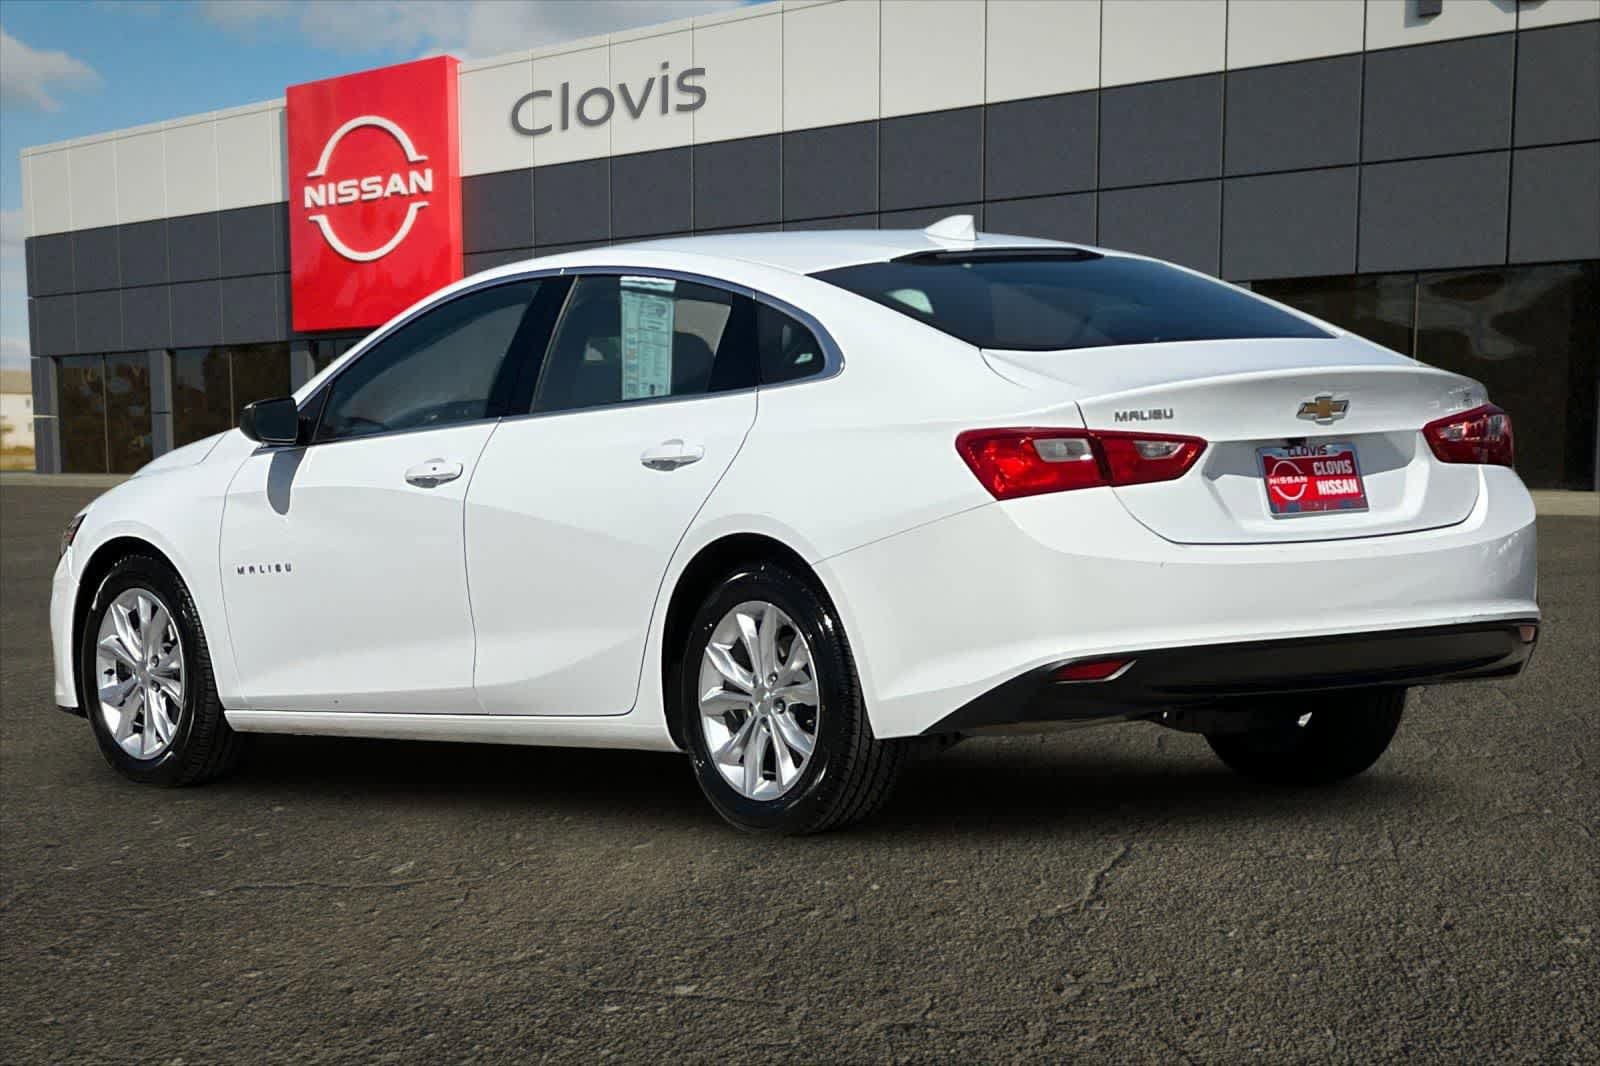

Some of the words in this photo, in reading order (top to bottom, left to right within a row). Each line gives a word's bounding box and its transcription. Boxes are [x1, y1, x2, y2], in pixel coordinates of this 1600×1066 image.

[511, 61, 707, 136] Clovis
[304, 168, 433, 209] NISSAN
[1114, 408, 1174, 422] MALIBU
[1287, 446, 1327, 457] CLOVIS
[1313, 460, 1353, 475] CLOVIS
[1268, 476, 1308, 485] NISSAN
[1316, 479, 1360, 495] NISSAN
[236, 563, 292, 575] MALIBU
